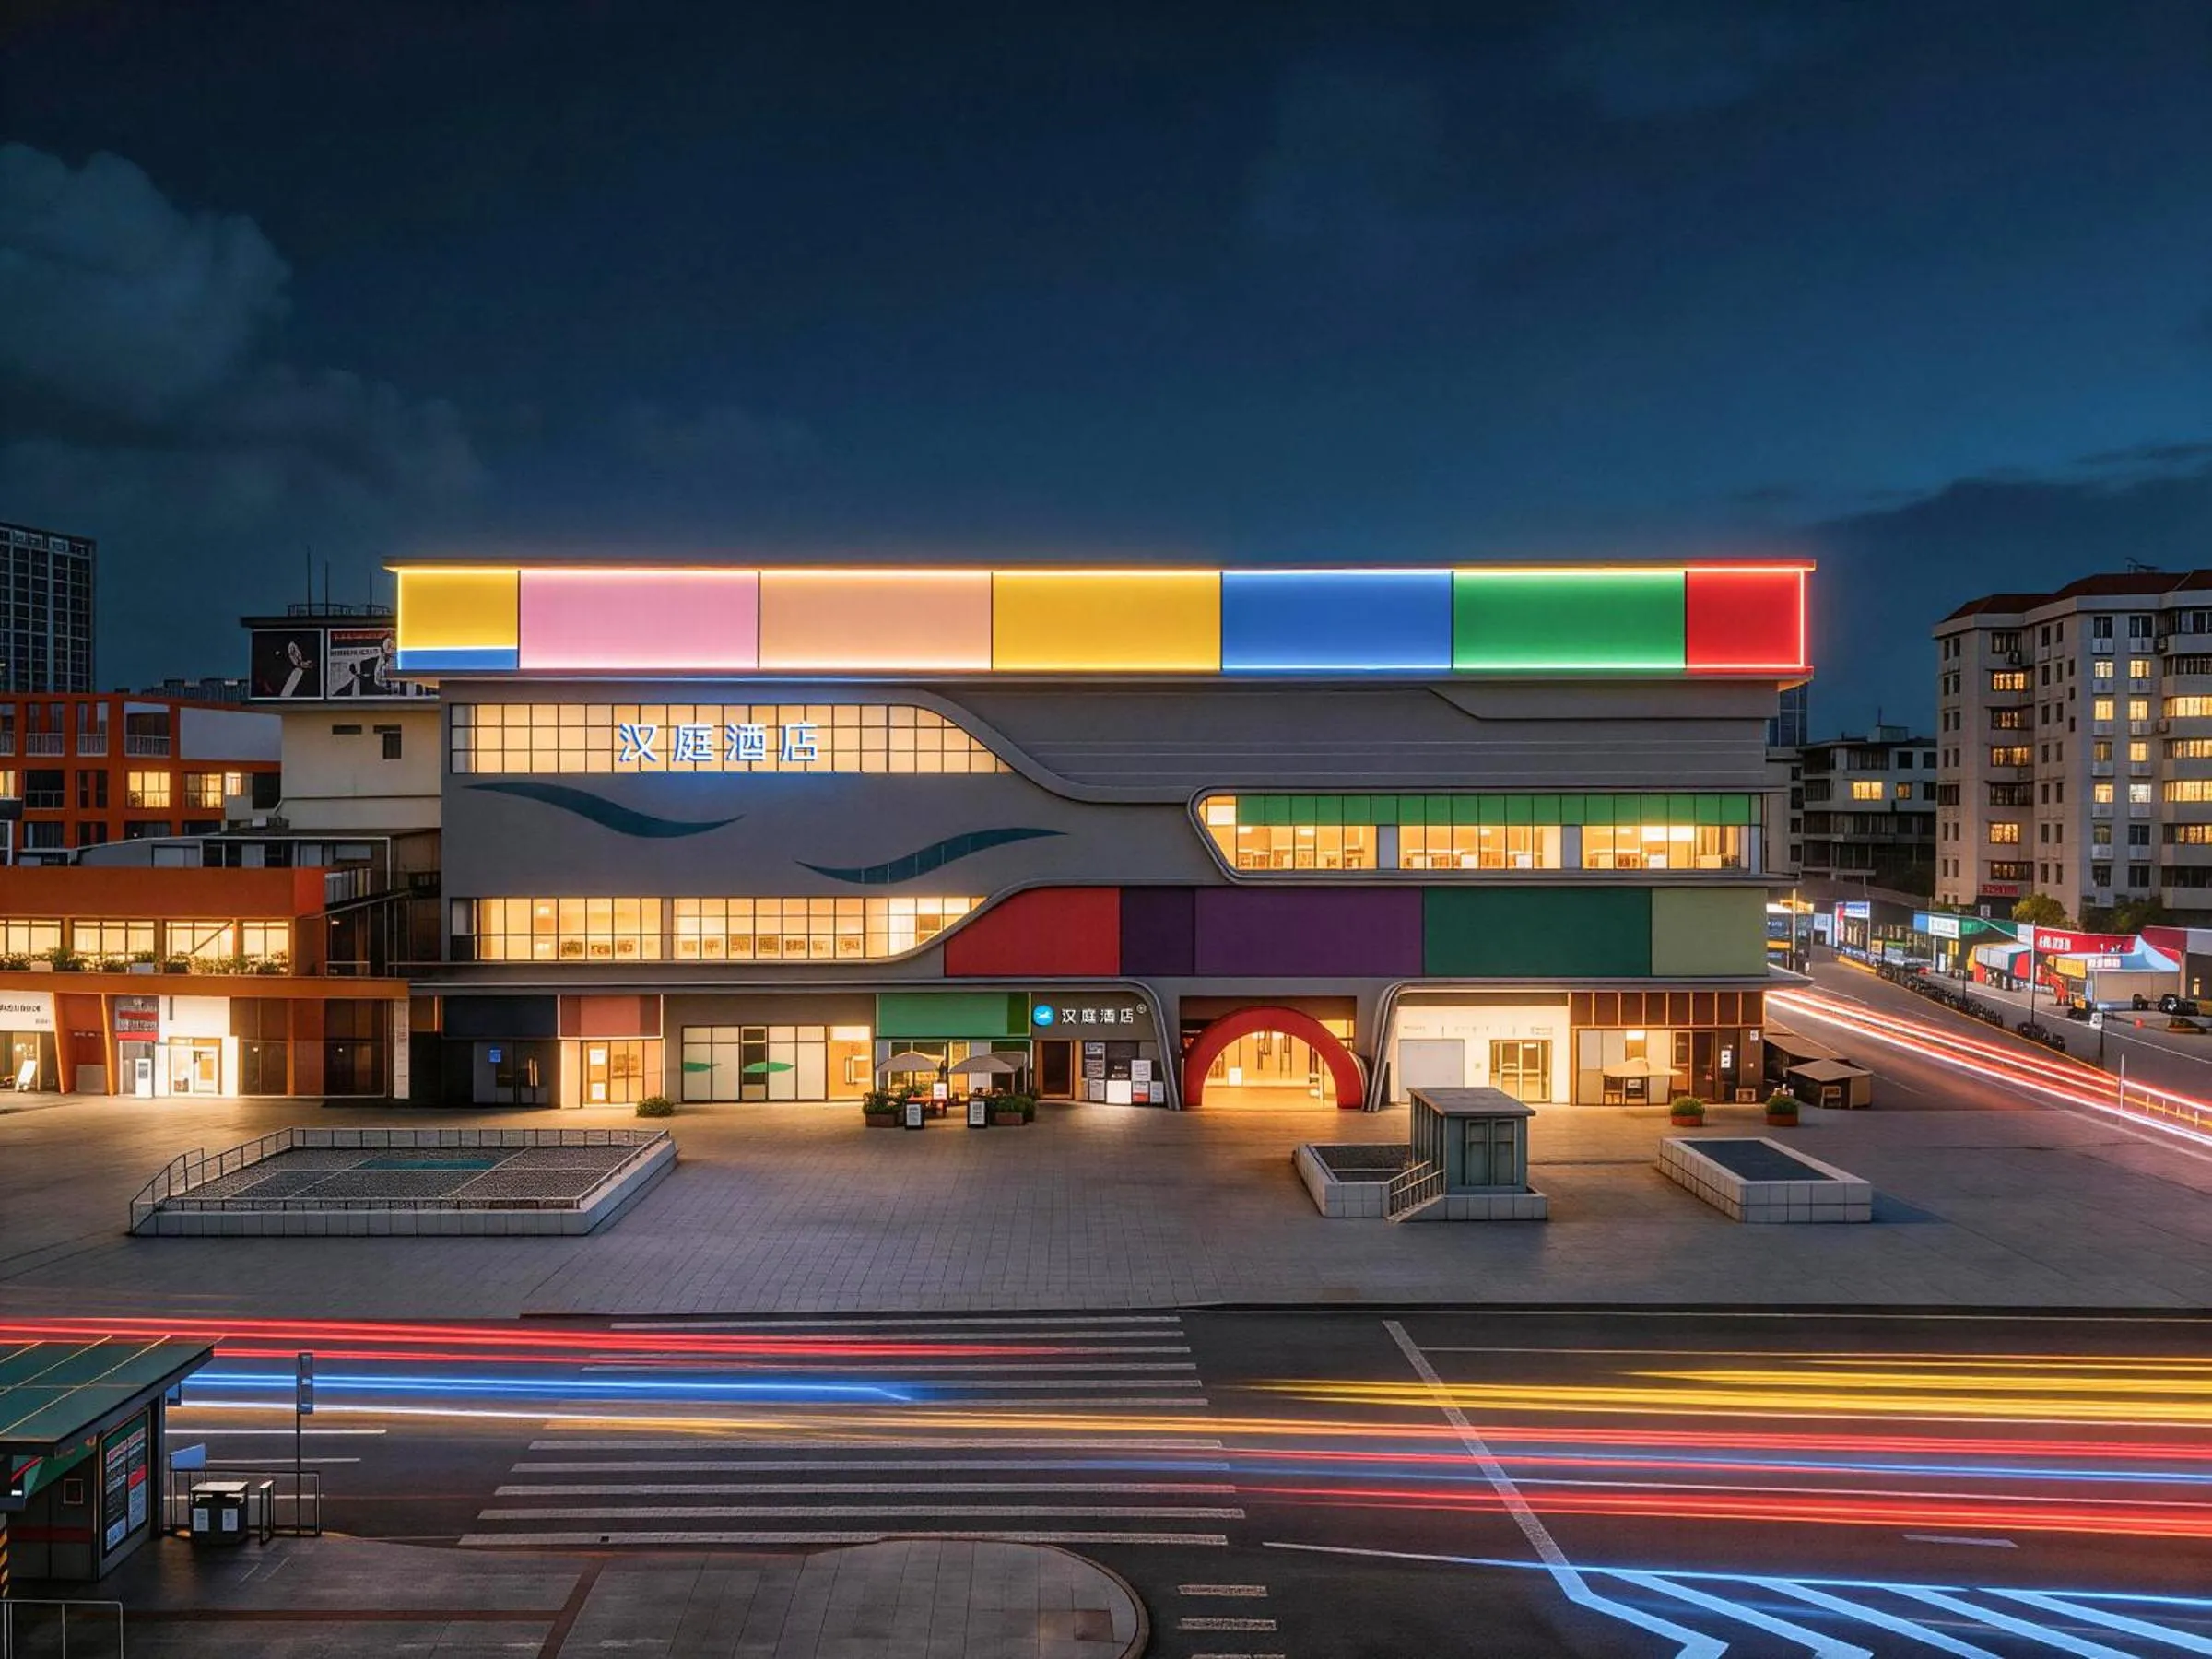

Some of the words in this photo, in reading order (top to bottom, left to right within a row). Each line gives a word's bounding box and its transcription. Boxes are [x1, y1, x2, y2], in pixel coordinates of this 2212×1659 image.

[618, 722, 818, 762] 汉庭酒店
[1061, 1008, 1134, 1025] 汉庭酒店
